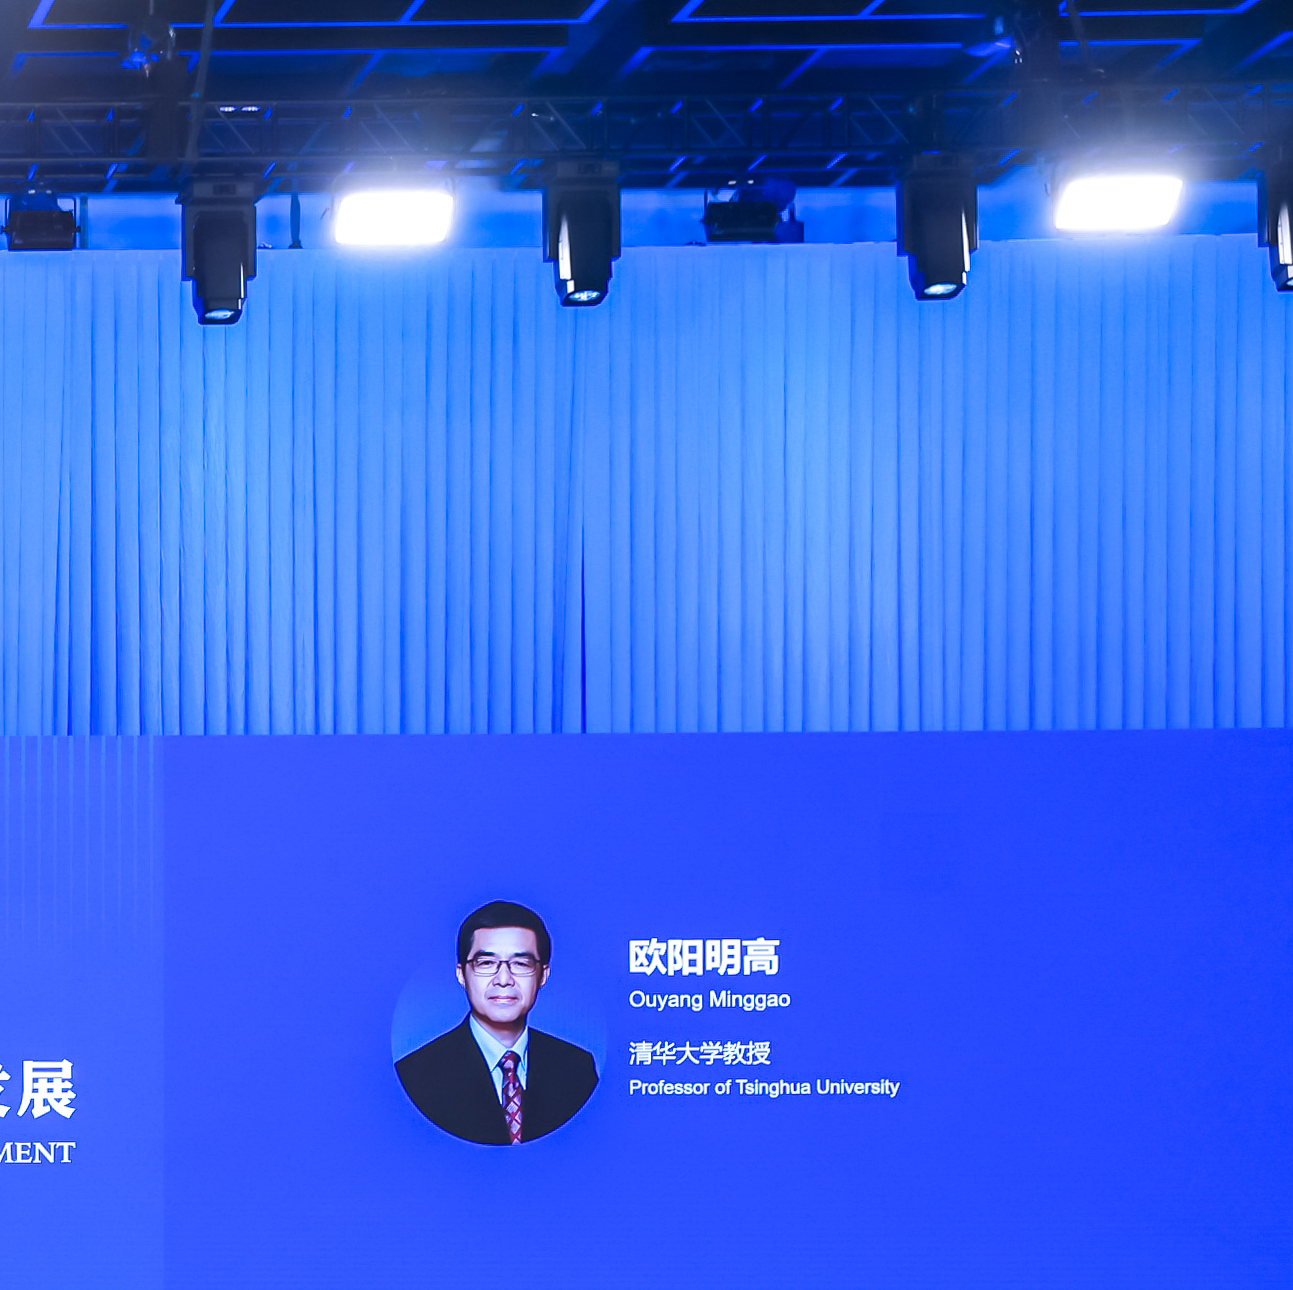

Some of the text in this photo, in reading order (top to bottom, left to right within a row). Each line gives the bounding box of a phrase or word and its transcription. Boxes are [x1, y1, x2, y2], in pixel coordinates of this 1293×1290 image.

[629, 937, 780, 976] 欧阳明高
[629, 990, 791, 1012] Ouyang Minggao
[628, 1041, 771, 1066] 清华大学教授
[629, 1078, 901, 1098] Professor of Tsinghua University
